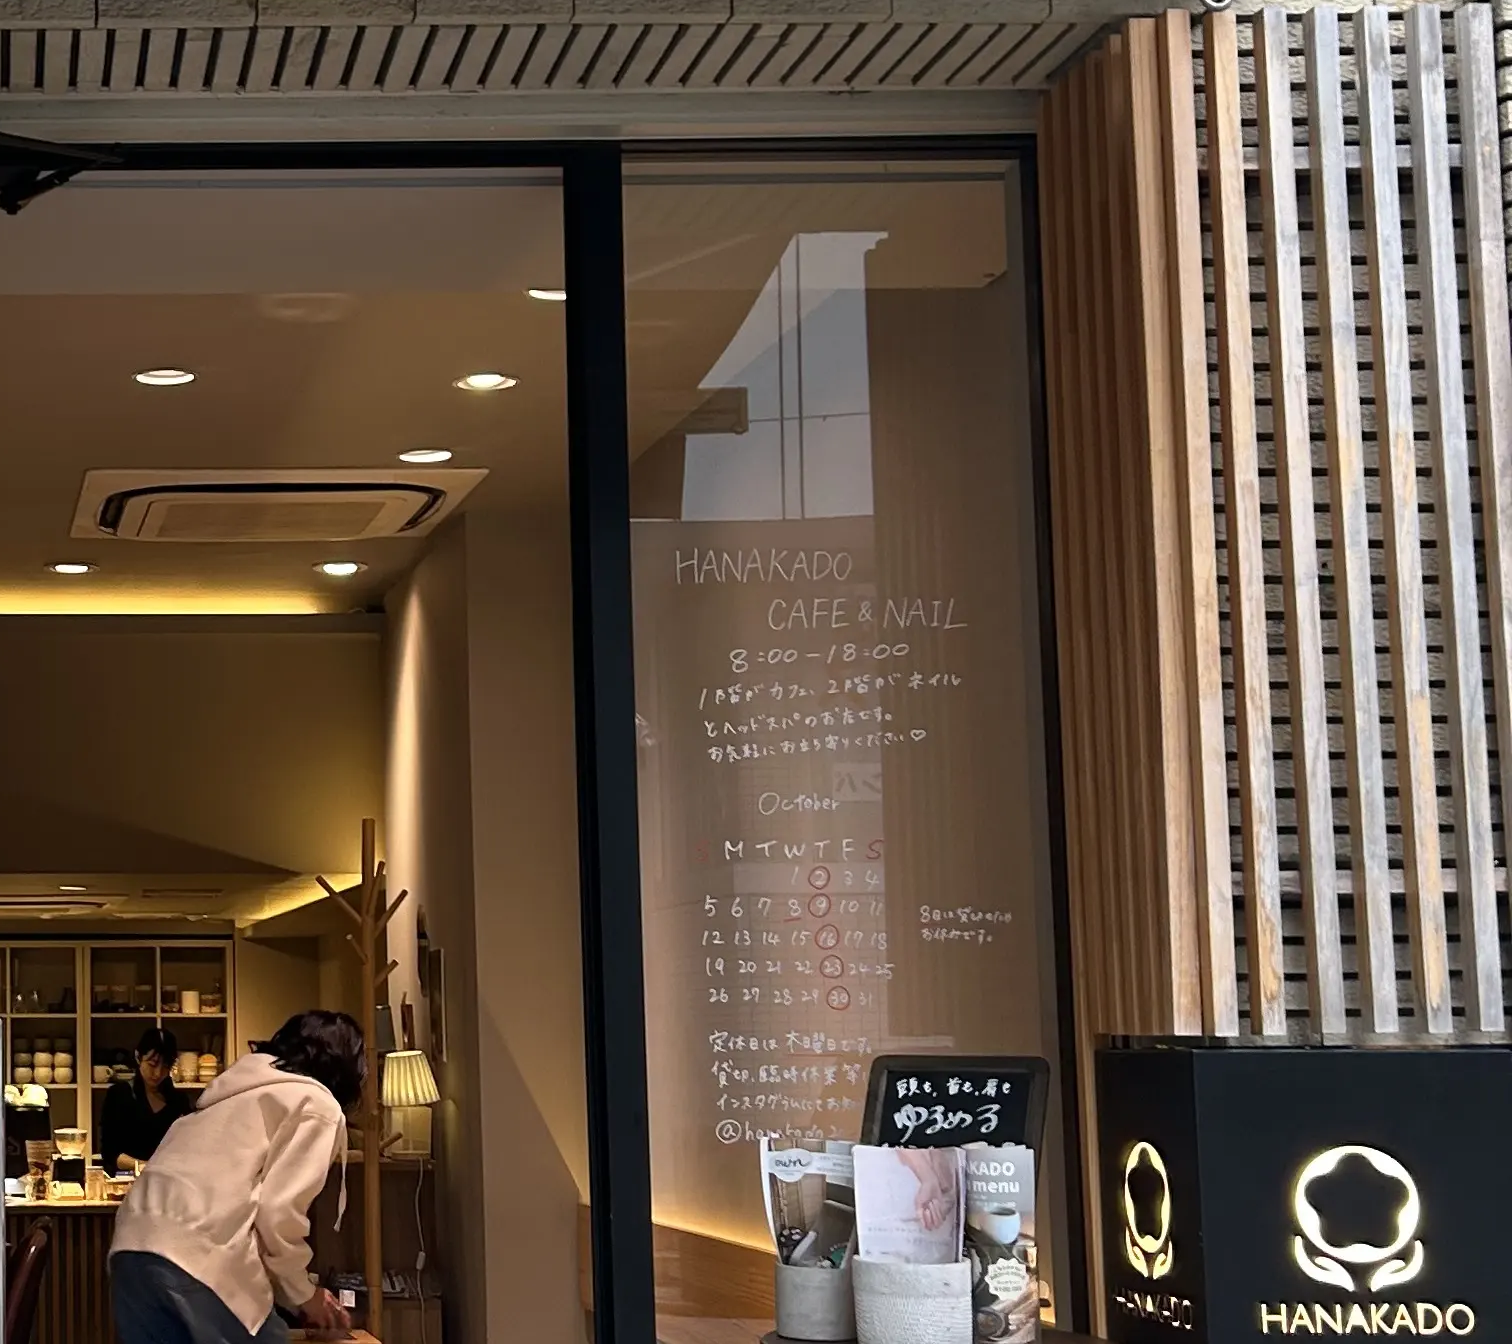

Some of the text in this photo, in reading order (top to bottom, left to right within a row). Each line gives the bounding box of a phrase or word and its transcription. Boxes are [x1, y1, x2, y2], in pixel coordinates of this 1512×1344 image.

[675, 548, 852, 584] HANAKADO
[768, 597, 968, 630] CAFE & NAIL
[758, 792, 840, 815] October
[724, 840, 744, 860] M
[755, 840, 777, 858] T
[783, 843, 806, 859] W
[814, 840, 831, 858] T
[842, 838, 855, 860] F
[865, 839, 886, 860] S
[791, 866, 799, 885] 1
[843, 870, 853, 886] 3
[864, 870, 879, 886] 4
[704, 894, 719, 917] 5
[730, 897, 743, 917] 6
[757, 897, 772, 915] 7
[788, 899, 802, 916] 8
[839, 900, 859, 913] 10
[869, 899, 883, 916] 11
[702, 930, 725, 946] 12
[734, 930, 752, 946] 13
[762, 930, 781, 946] 14
[791, 930, 812, 946] 15
[844, 930, 864, 946] 17
[870, 932, 888, 950] 18
[706, 957, 725, 976] 19
[738, 960, 757, 973] 20
[766, 960, 781, 974] 21
[794, 960, 814, 973] 22
[848, 962, 869, 976] 24
[875, 962, 895, 979] 25
[708, 988, 729, 1003] 26
[742, 987, 760, 1003] 27
[773, 988, 793, 1005] 28
[801, 989, 819, 1004] 29
[859, 992, 872, 1006] 31
[892, 1103, 1002, 1143] ゆるめる
[972, 1180, 1020, 1193] menu
[1260, 1302, 1475, 1336] HANAKADO
